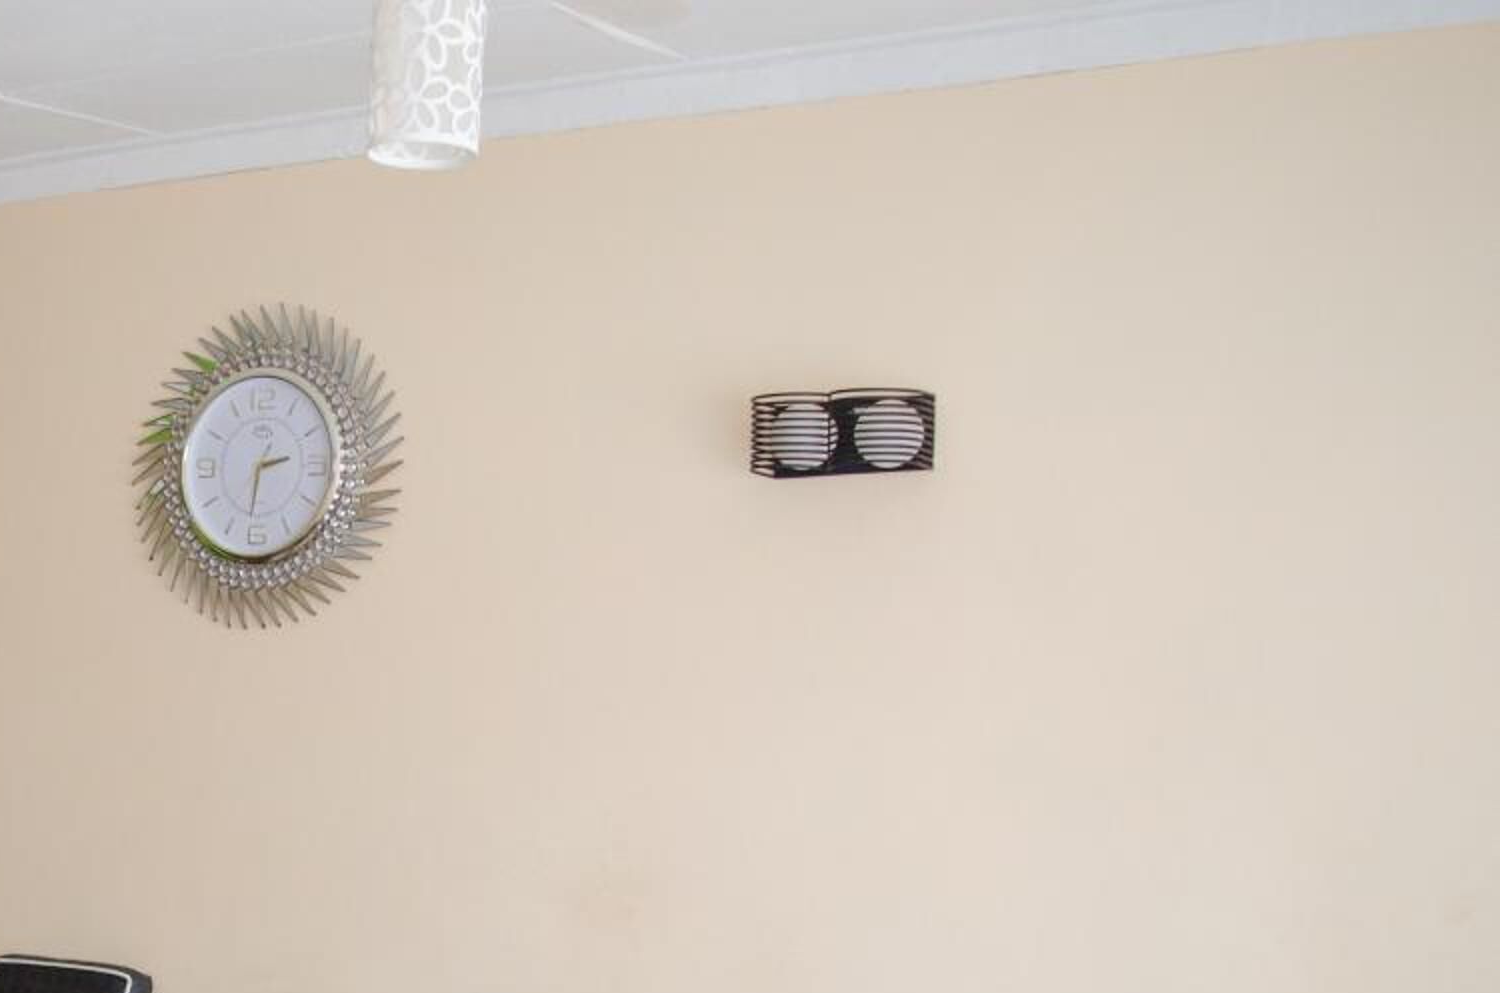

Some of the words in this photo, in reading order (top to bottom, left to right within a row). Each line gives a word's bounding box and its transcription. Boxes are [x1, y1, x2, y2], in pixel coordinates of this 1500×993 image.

[249, 388, 276, 412] 12
[195, 456, 216, 479] 9
[307, 455, 326, 477] 3
[247, 524, 267, 545] 6
